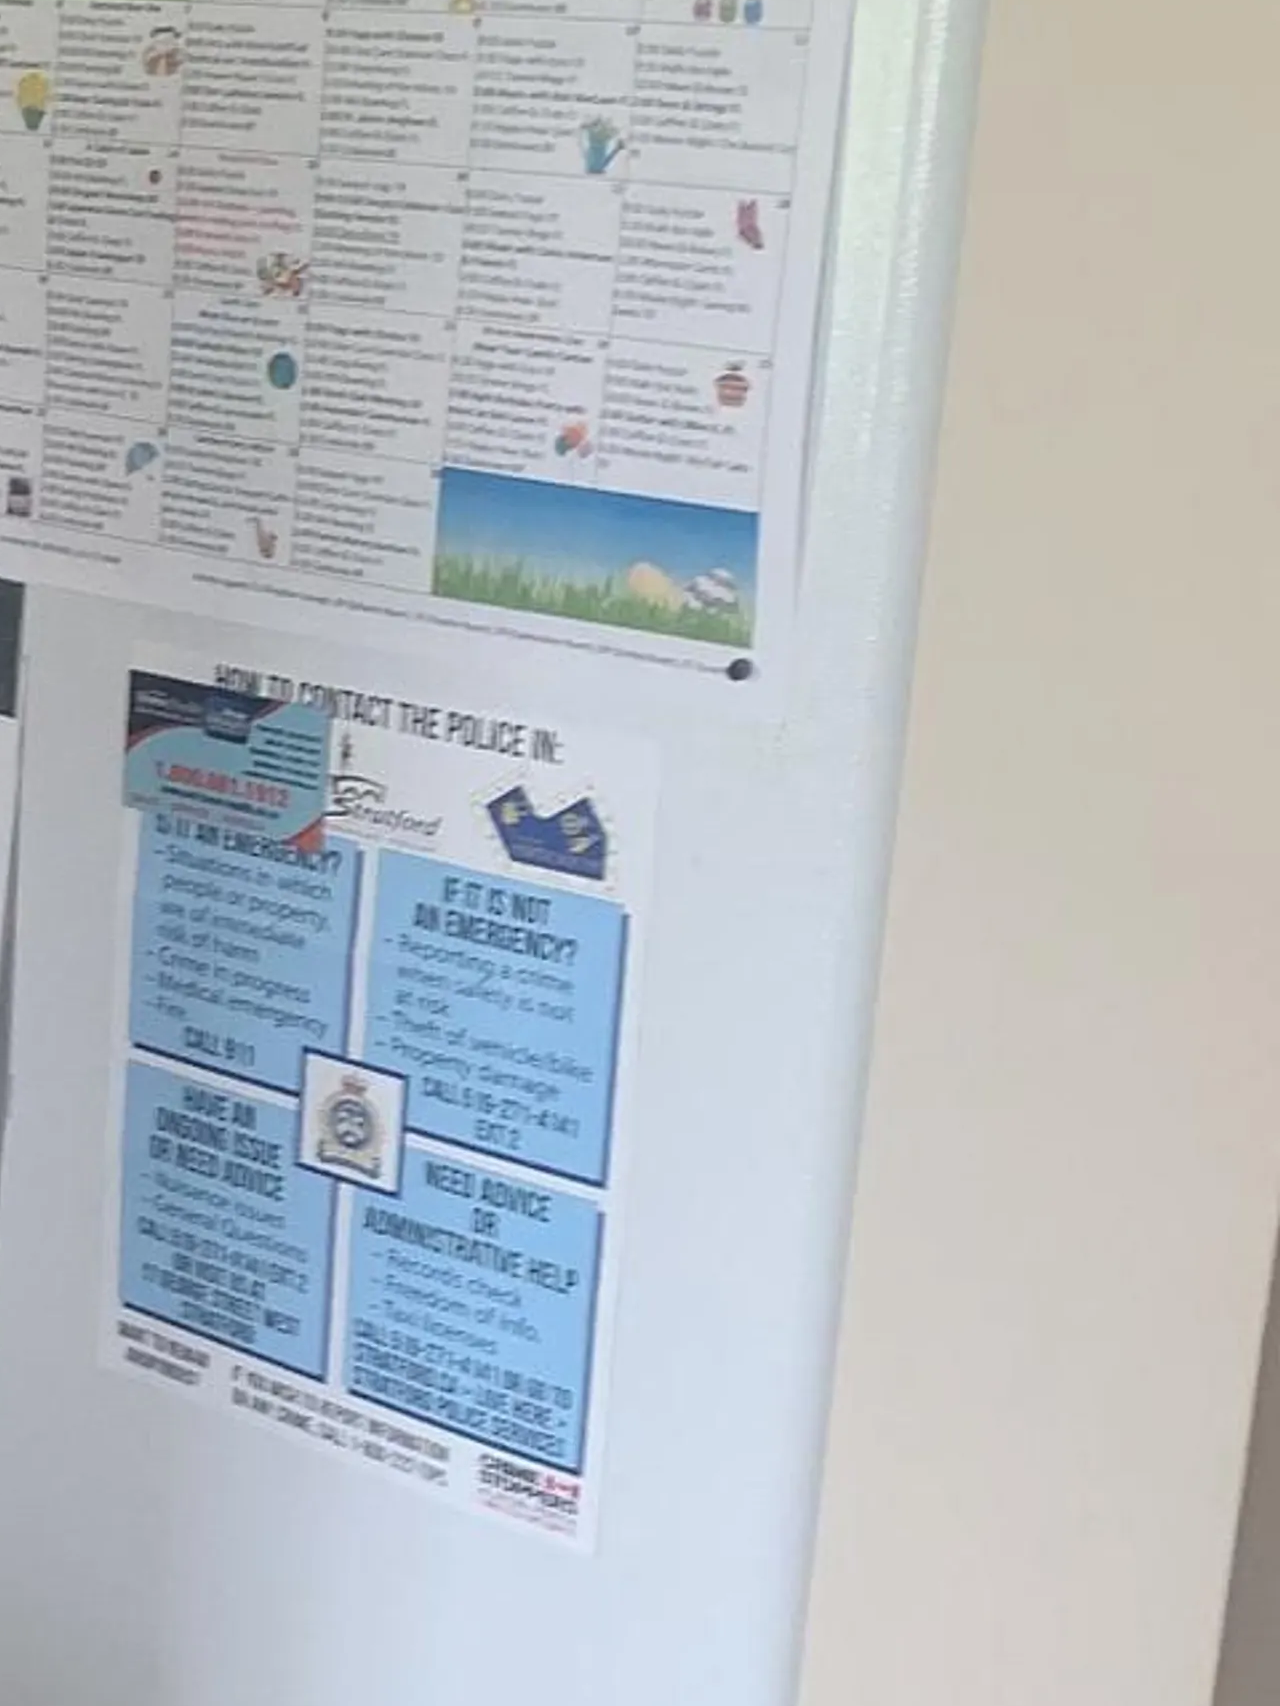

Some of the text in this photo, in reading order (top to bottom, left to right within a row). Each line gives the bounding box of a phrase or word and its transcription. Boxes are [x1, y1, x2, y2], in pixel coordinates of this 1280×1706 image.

[297, 681, 392, 728] CONTACT
[395, 701, 440, 740] THE
[445, 710, 528, 757] POLICE
[442, 908, 579, 968] EMERGENCY?
[510, 891, 552, 927] NOT
[153, 1103, 283, 1171] ONGOING ISSUE
[175, 1141, 220, 1181] NEED
[220, 1156, 288, 1204] ADVICE
[425, 1159, 553, 1225] NEED ADVICE
[362, 1202, 579, 1299] ADMINISTRATIVE HELP
[470, 1204, 501, 1240] OR
